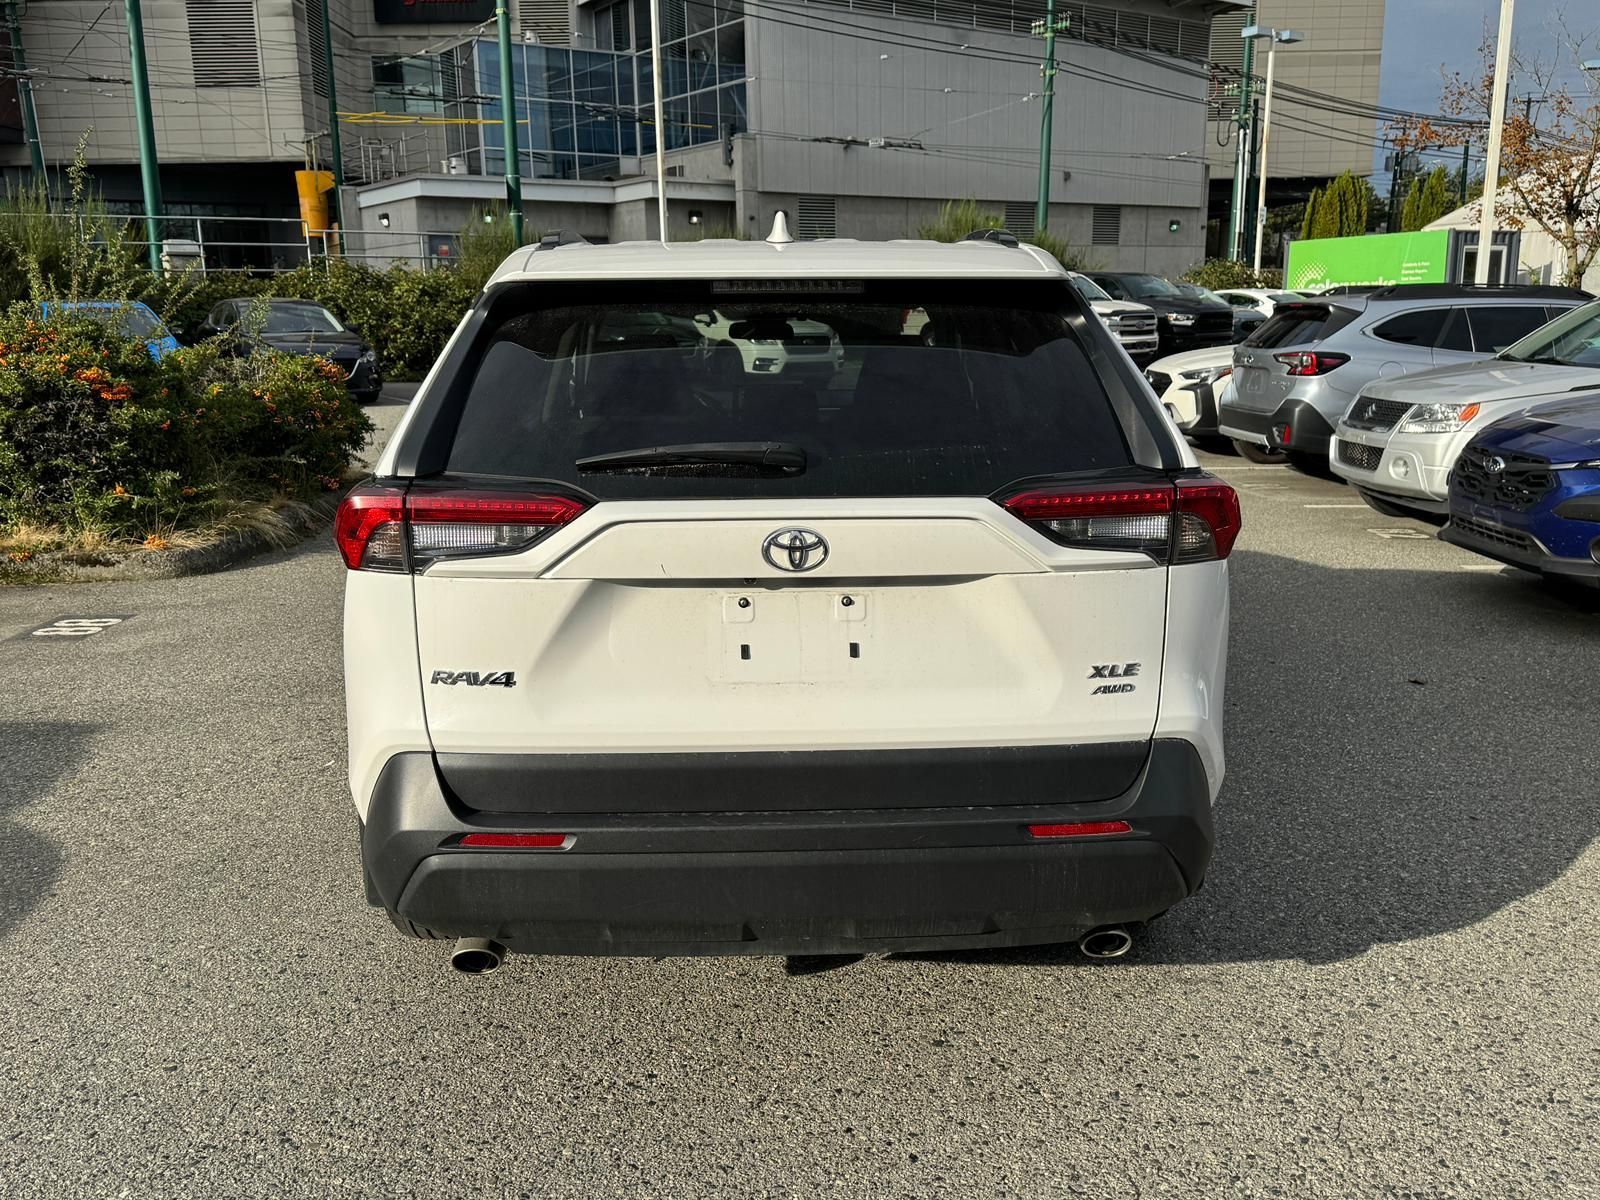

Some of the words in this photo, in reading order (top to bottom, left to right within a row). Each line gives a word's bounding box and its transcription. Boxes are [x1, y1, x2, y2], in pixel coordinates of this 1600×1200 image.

[430, 670, 516, 687] RAV4
[1087, 663, 1141, 679] XLE
[1091, 684, 1136, 695] AWD
